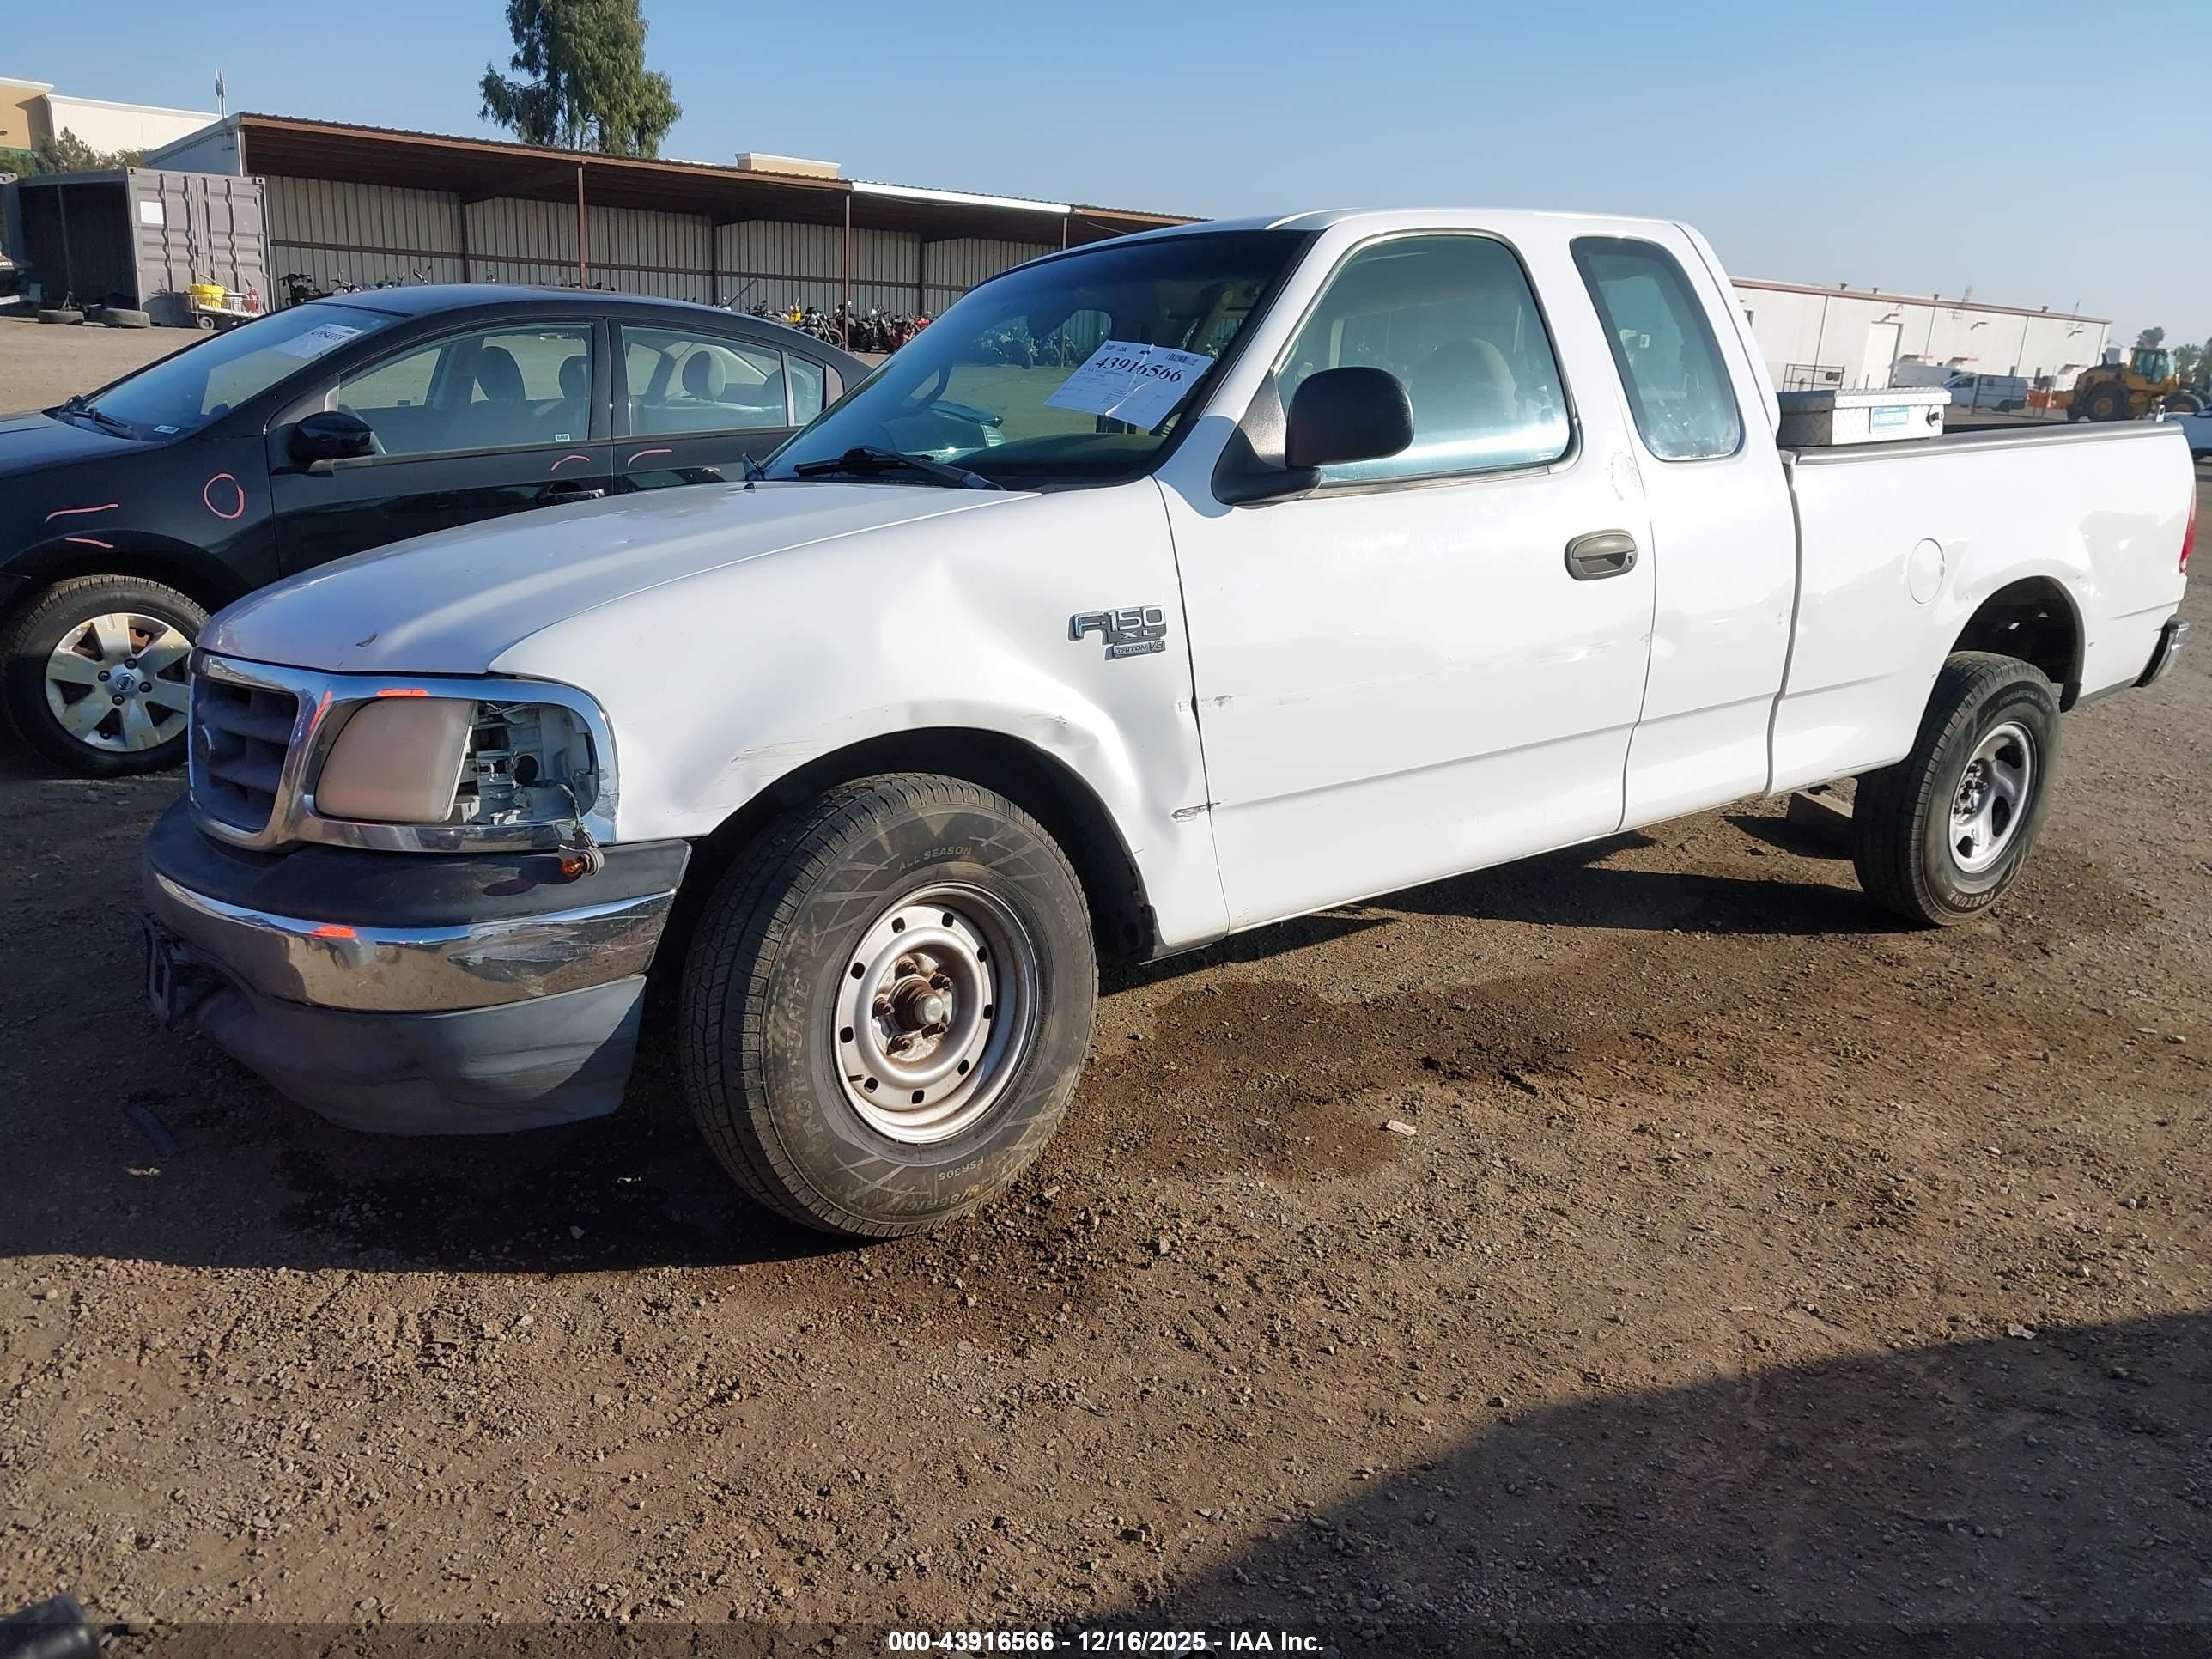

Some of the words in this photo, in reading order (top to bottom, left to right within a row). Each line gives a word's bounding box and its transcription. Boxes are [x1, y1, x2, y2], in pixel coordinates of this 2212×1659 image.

[1096, 356, 1182, 383] 43916566
[1115, 644, 1146, 654] TRITON
[1147, 640, 1164, 653] V8
[1120, 629, 1158, 640] XL
[898, 854, 921, 873] ALL
[922, 846, 973, 861] SEASON
[1946, 888, 1996, 908] FORTUNE
[785, 975, 824, 1140] FORTUNE
[938, 1155, 985, 1181] FSR305
